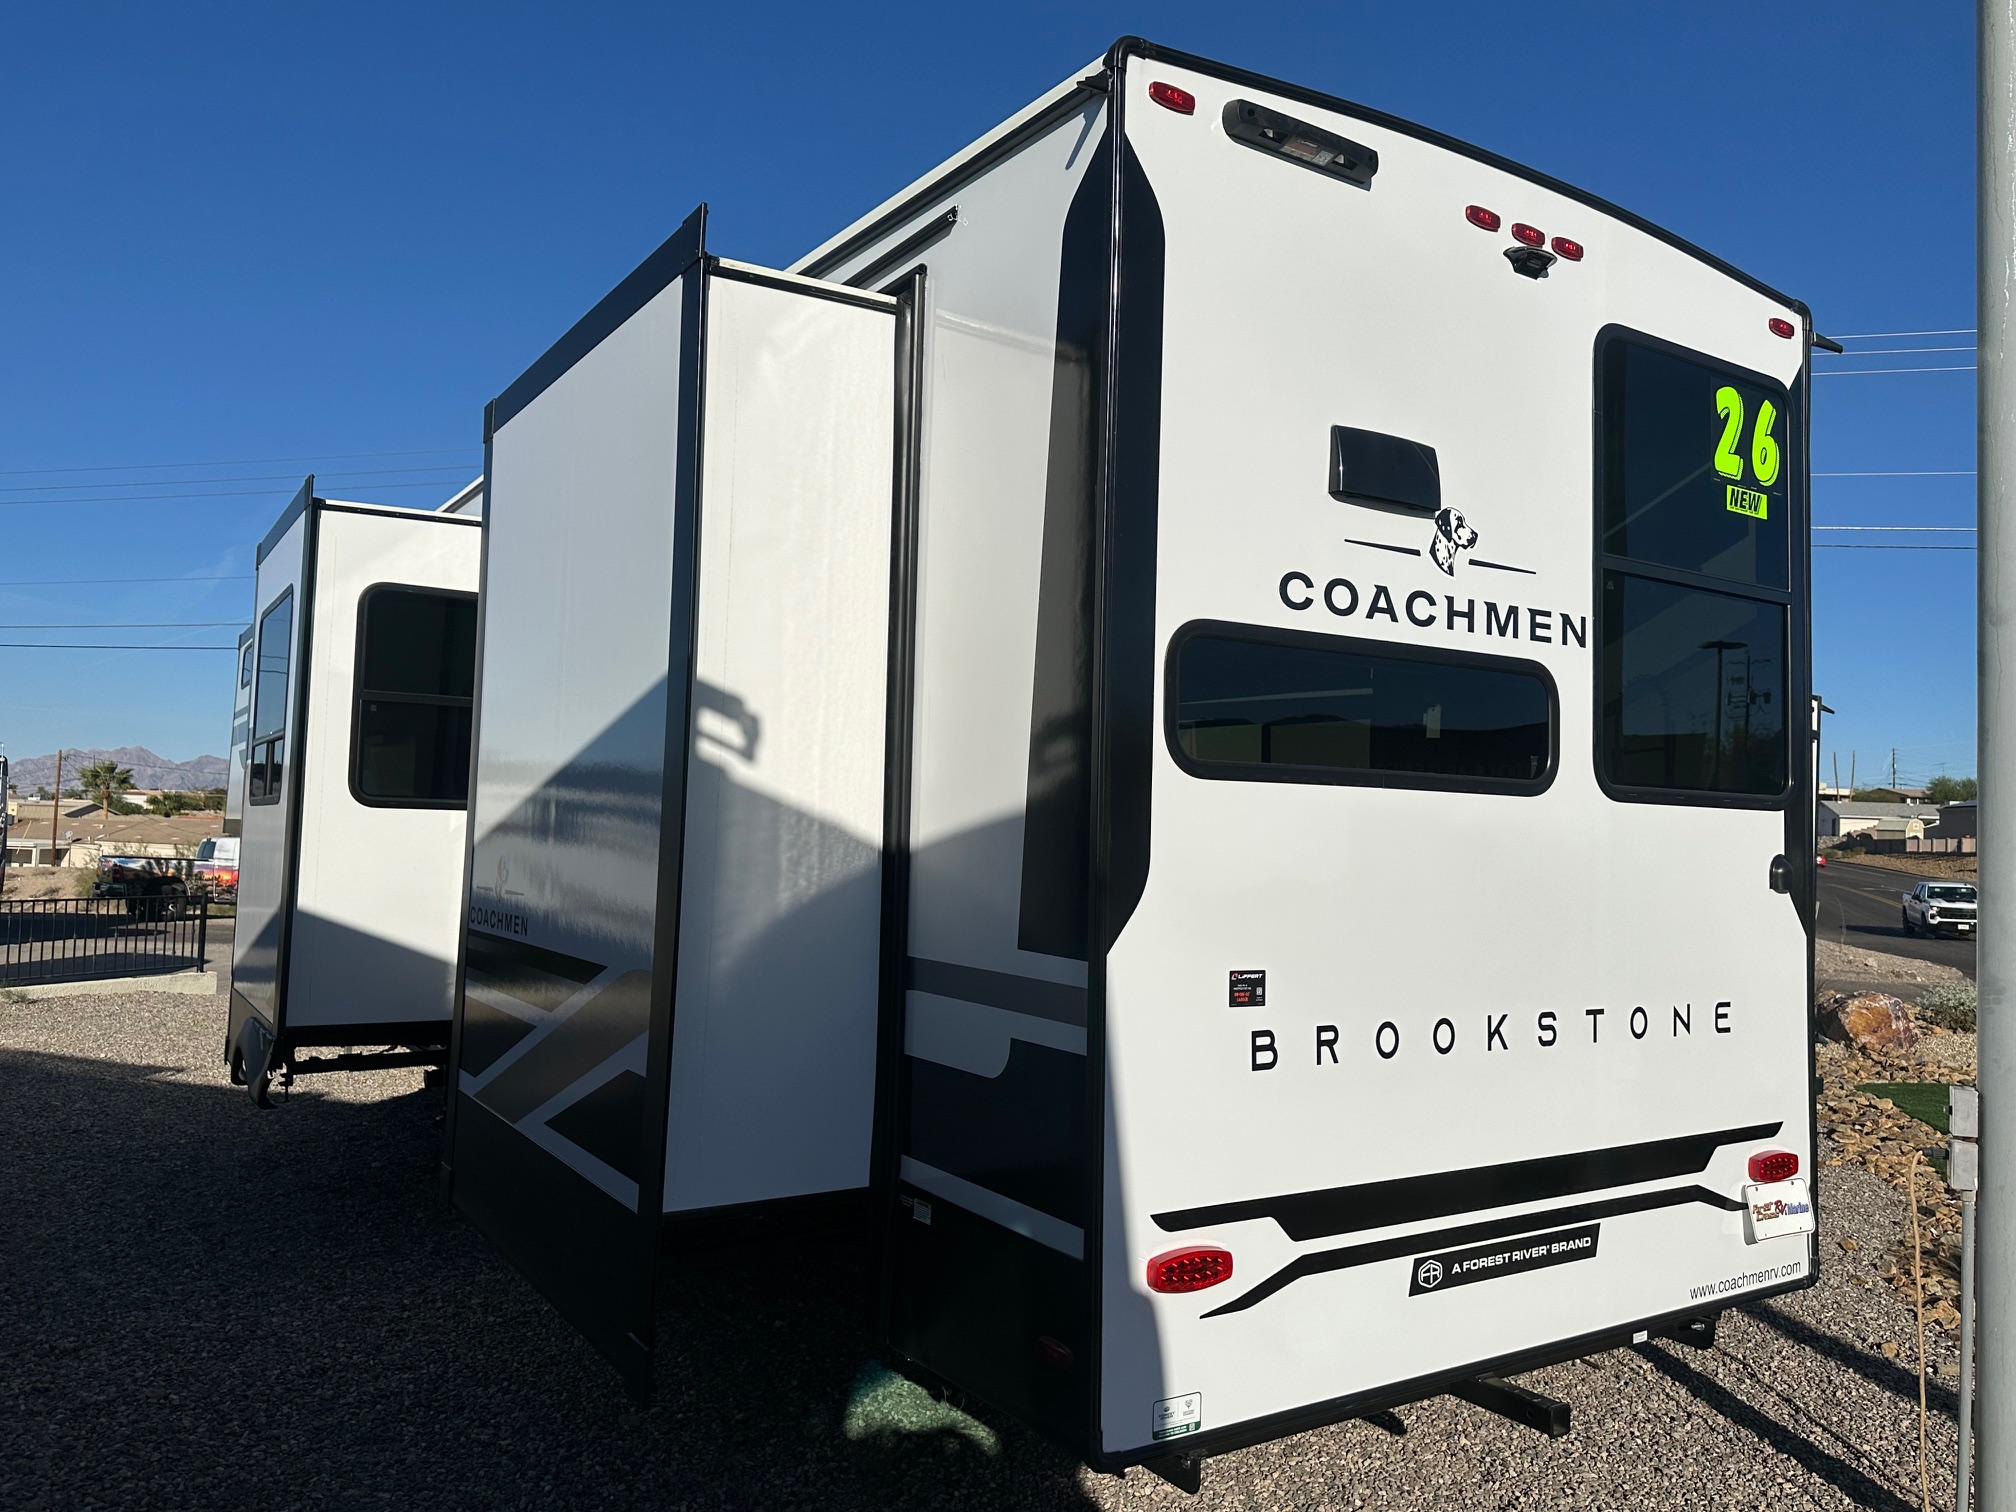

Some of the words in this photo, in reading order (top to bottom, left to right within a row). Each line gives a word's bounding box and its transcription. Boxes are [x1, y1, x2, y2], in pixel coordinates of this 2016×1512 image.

[1714, 386, 1780, 487] 26
[1729, 488, 1763, 515] NEW
[1279, 571, 1587, 649] COACHMEN
[469, 906, 528, 936] COACHMEN
[1251, 1001, 1732, 1072] BROOKSTONE
[1451, 1263, 1462, 1275] A
[1463, 1253, 1511, 1272] FOREST
[1551, 1236, 1592, 1254] BRAND
[1689, 1261, 1802, 1300] www.coachmenrv.com
